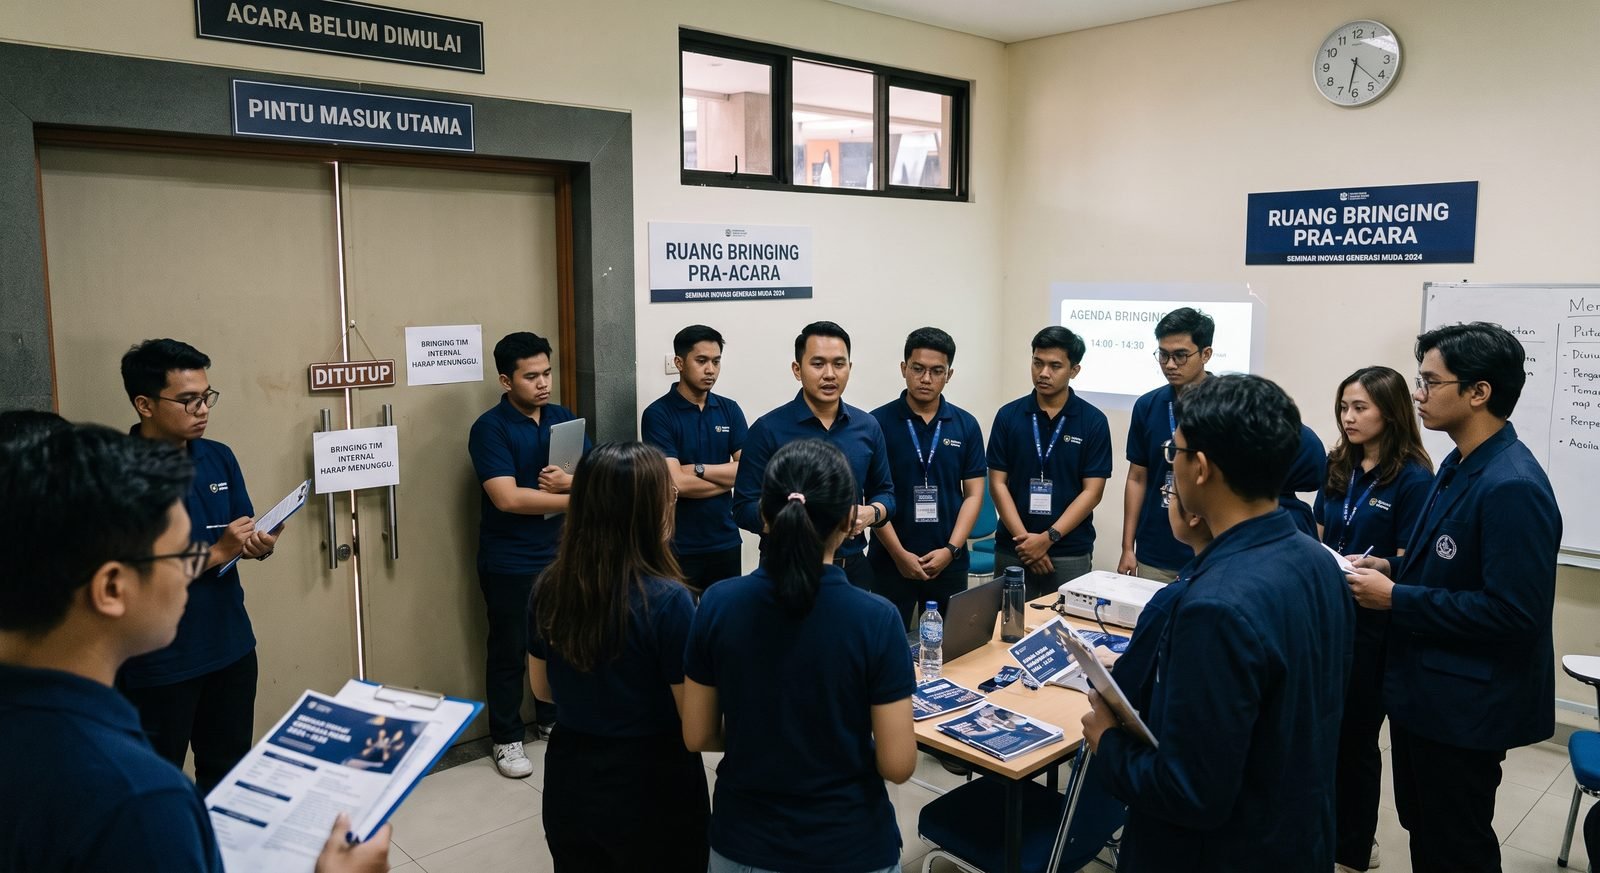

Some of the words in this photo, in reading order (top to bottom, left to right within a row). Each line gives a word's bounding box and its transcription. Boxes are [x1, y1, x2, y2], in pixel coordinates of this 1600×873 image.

[226, 2, 304, 31] ACARA
[309, 14, 378, 42] BELUM
[384, 25, 462, 53] DIMULAI
[1352, 29, 1363, 39] 12
[1338, 36, 1346, 46] 11
[1327, 48, 1337, 58] 10
[1383, 55, 1391, 64] 3
[1323, 63, 1330, 72] 9
[1378, 70, 1385, 79] 4
[1327, 77, 1334, 86] 8
[1368, 82, 1374, 91] 5
[1338, 86, 1344, 95] 7
[1351, 88, 1358, 98] 6
[248, 98, 314, 123] PINTU
[320, 106, 392, 130] MASUK
[397, 113, 462, 136] UTAMA
[1268, 207, 1337, 227] RUANG
[1343, 202, 1449, 225] BRINGING
[1294, 226, 1418, 247] PRA-ACARA
[666, 243, 723, 260] RUANG
[728, 244, 799, 261] BRINGING
[1346, 254, 1380, 262] GENERASI
[1404, 253, 1423, 261] 2024
[689, 264, 781, 281] PRA-ACARA
[1070, 310, 1112, 321] AGENDA
[421, 340, 454, 348] BRINGING
[1091, 339, 1113, 349] 14:00
[1121, 340, 1145, 350] 14:30
[412, 360, 435, 368] HARAP
[436, 358, 479, 367] MENUNGGU.
[315, 365, 391, 385] DITUTUP
[330, 443, 367, 453] BRINGING
[369, 442, 383, 450] TIM
[338, 453, 375, 463] INTERNAL
[320, 466, 346, 475] HARAP
[347, 461, 394, 472] MENUNGGU.
